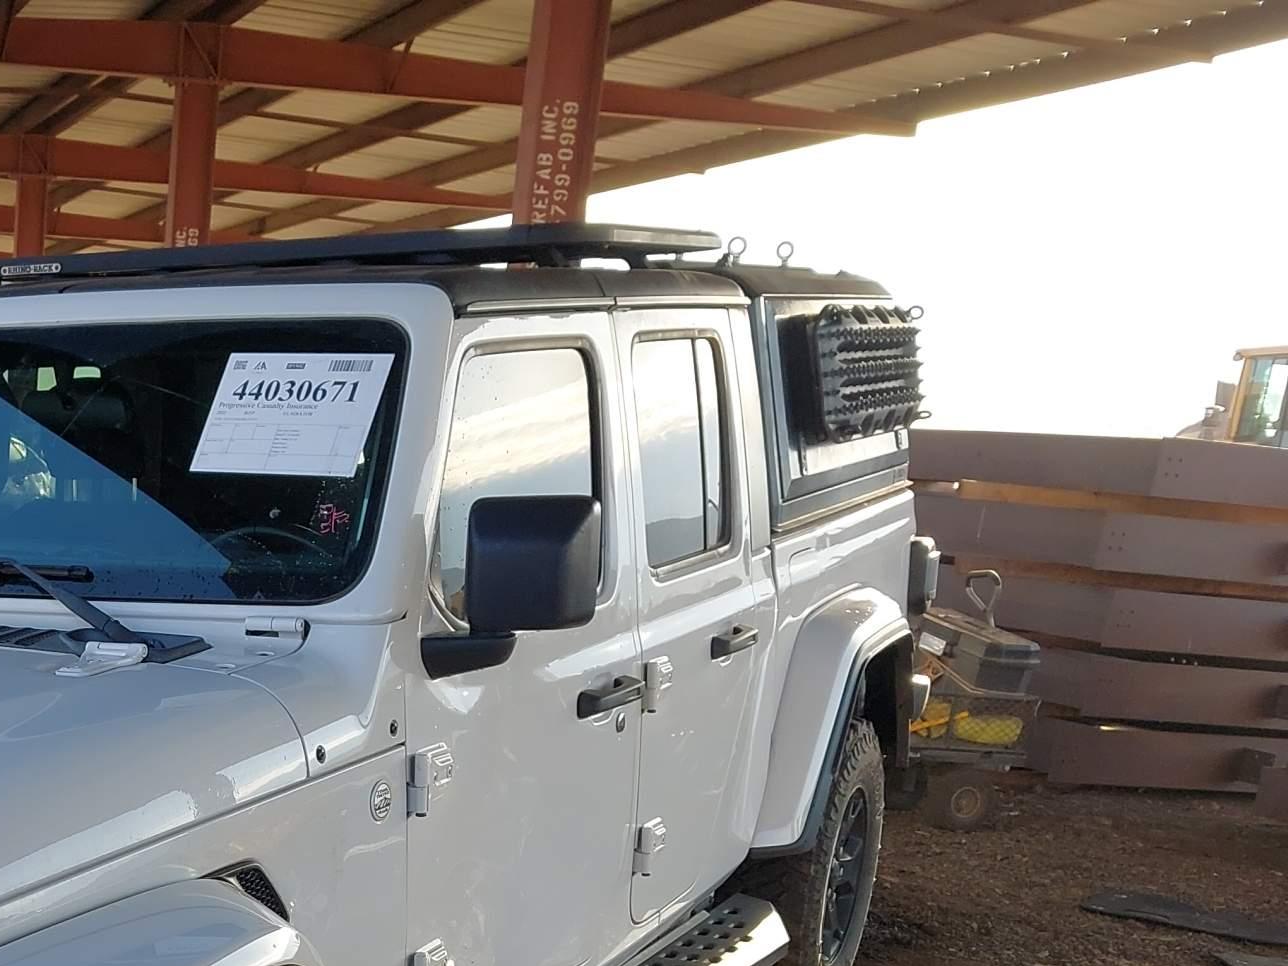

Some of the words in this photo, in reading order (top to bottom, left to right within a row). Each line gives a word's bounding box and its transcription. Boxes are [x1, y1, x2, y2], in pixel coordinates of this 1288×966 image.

[540, 98, 561, 140] INC.
[551, 101, 580, 223] 799-0969
[218, 401, 255, 410] Progressive
[257, 401, 285, 410] Casualty
[286, 402, 319, 410] Insurance
[232, 379, 360, 402] 44030671
